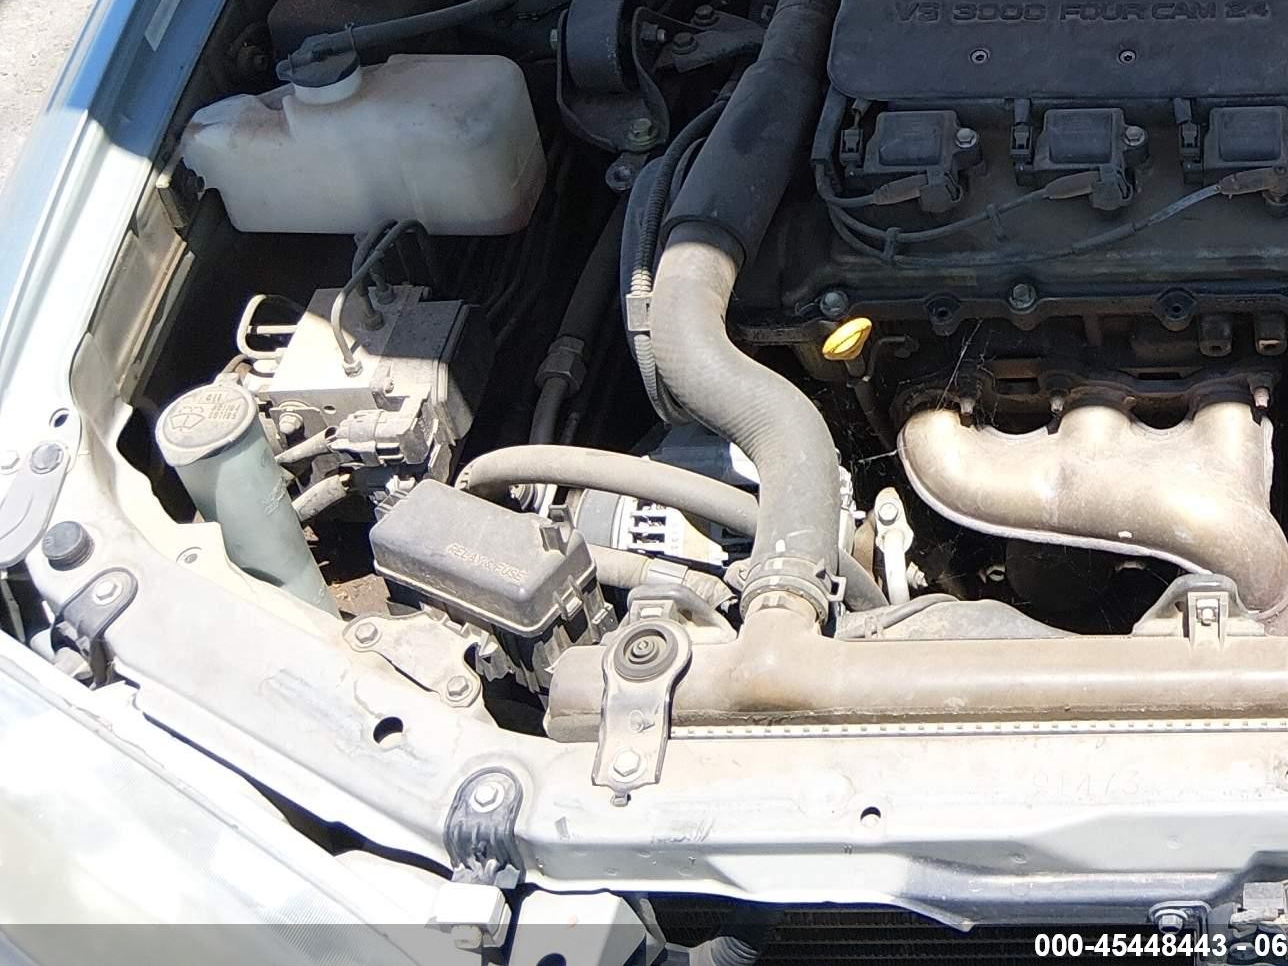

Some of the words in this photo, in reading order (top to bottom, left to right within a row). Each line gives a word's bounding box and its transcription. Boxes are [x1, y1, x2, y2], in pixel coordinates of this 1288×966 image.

[896, 1, 940, 22] V6
[952, 1, 1047, 22] 3000
[1059, 1, 1145, 21] FOUR
[1151, 1, 1217, 20] CAM
[1224, 0, 1269, 19] 24
[447, 543, 485, 564] RELAY
[495, 563, 529, 582] FUSE
